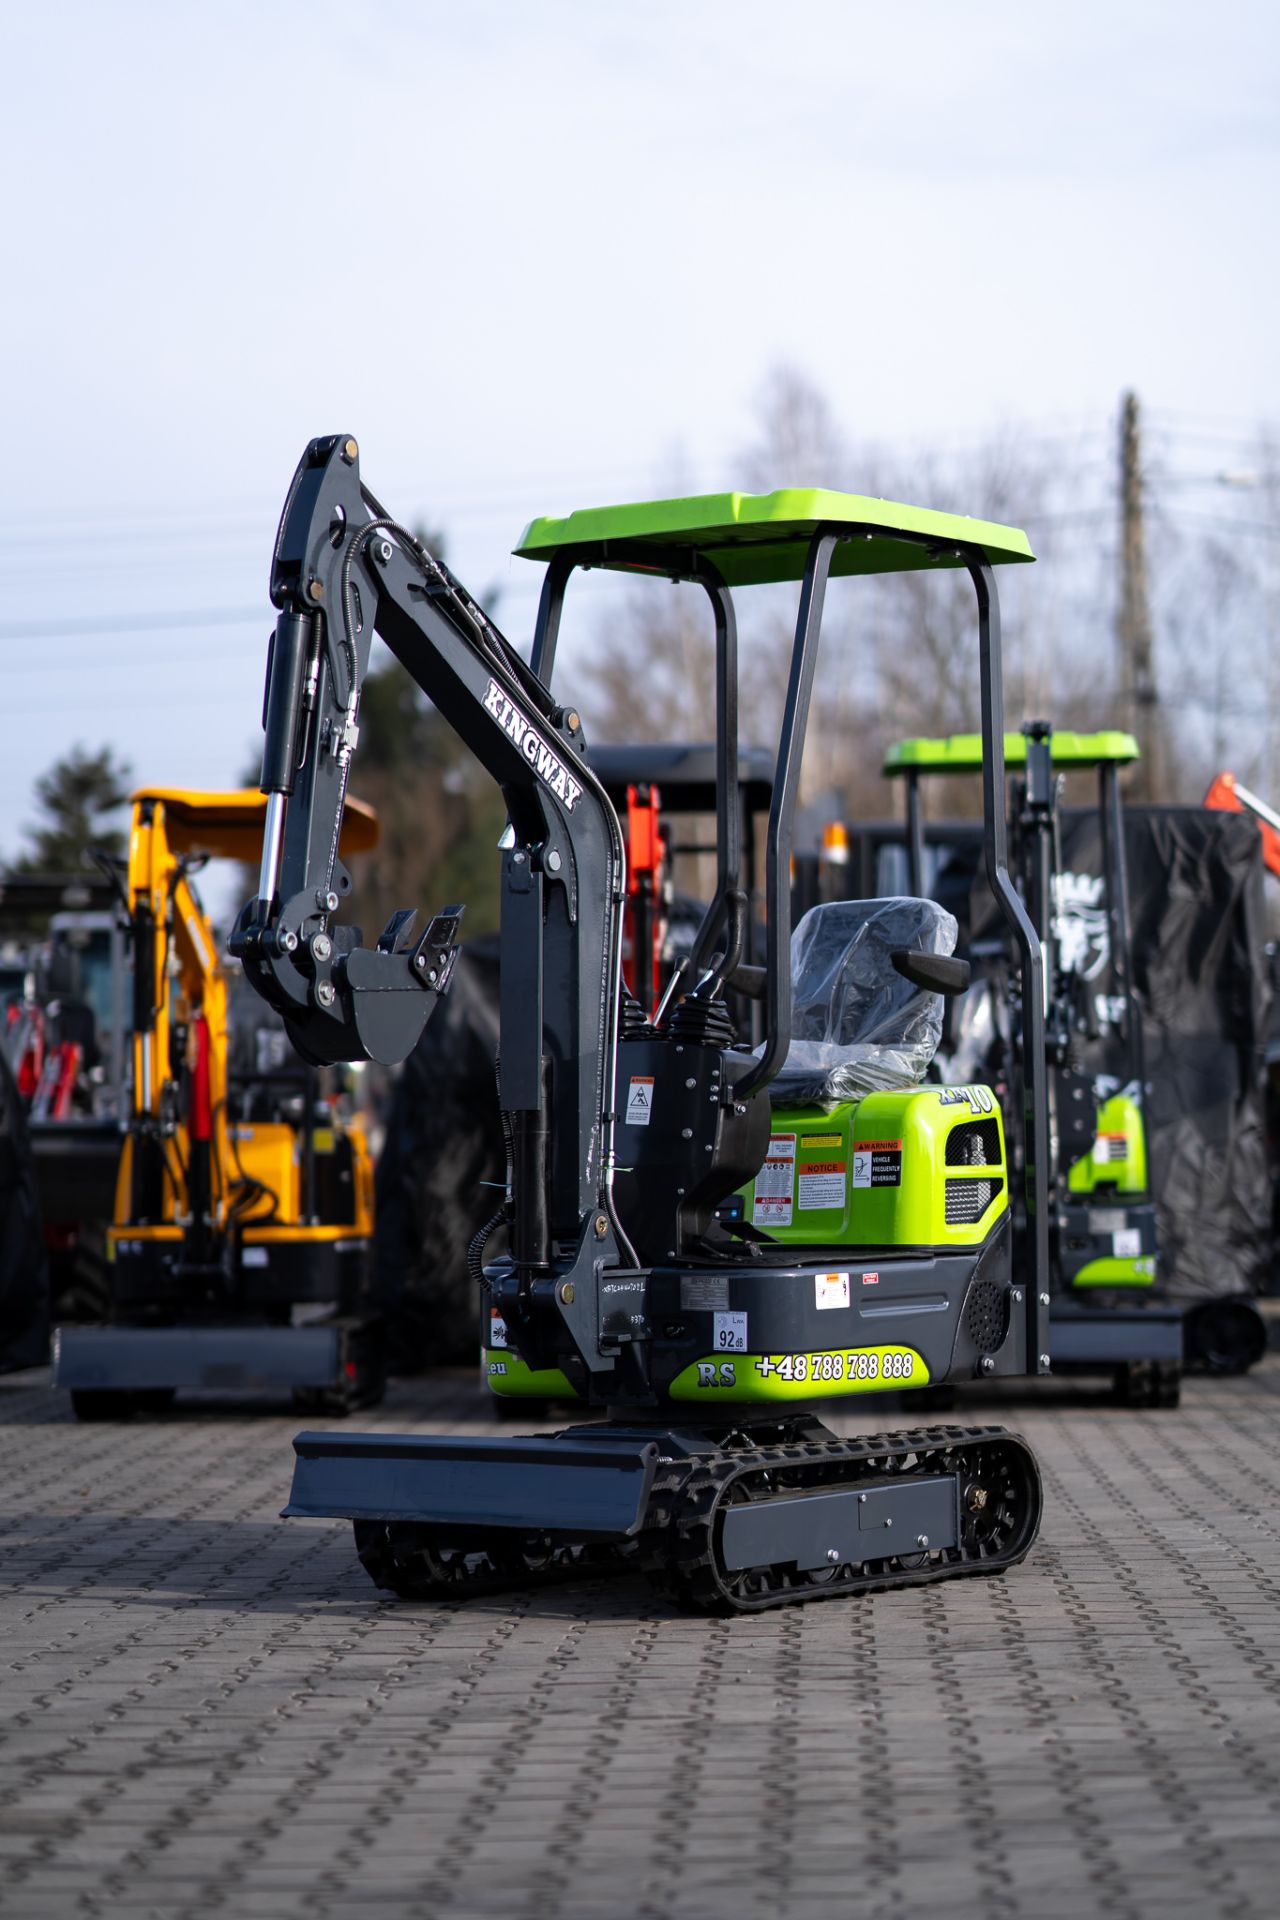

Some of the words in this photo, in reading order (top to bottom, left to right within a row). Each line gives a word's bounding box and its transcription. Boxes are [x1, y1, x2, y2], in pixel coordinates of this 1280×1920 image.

[483, 681, 583, 812] KINGWAY
[864, 1142, 898, 1150] WARNING
[807, 1163, 838, 1173] NOTICE
[719, 1330, 735, 1348] 92
[735, 1337, 744, 1348] dB
[698, 1363, 737, 1387] RS
[756, 1354, 807, 1381] +48
[811, 1354, 843, 1380] 788
[847, 1353, 879, 1379] 788
[882, 1352, 913, 1378] 888
